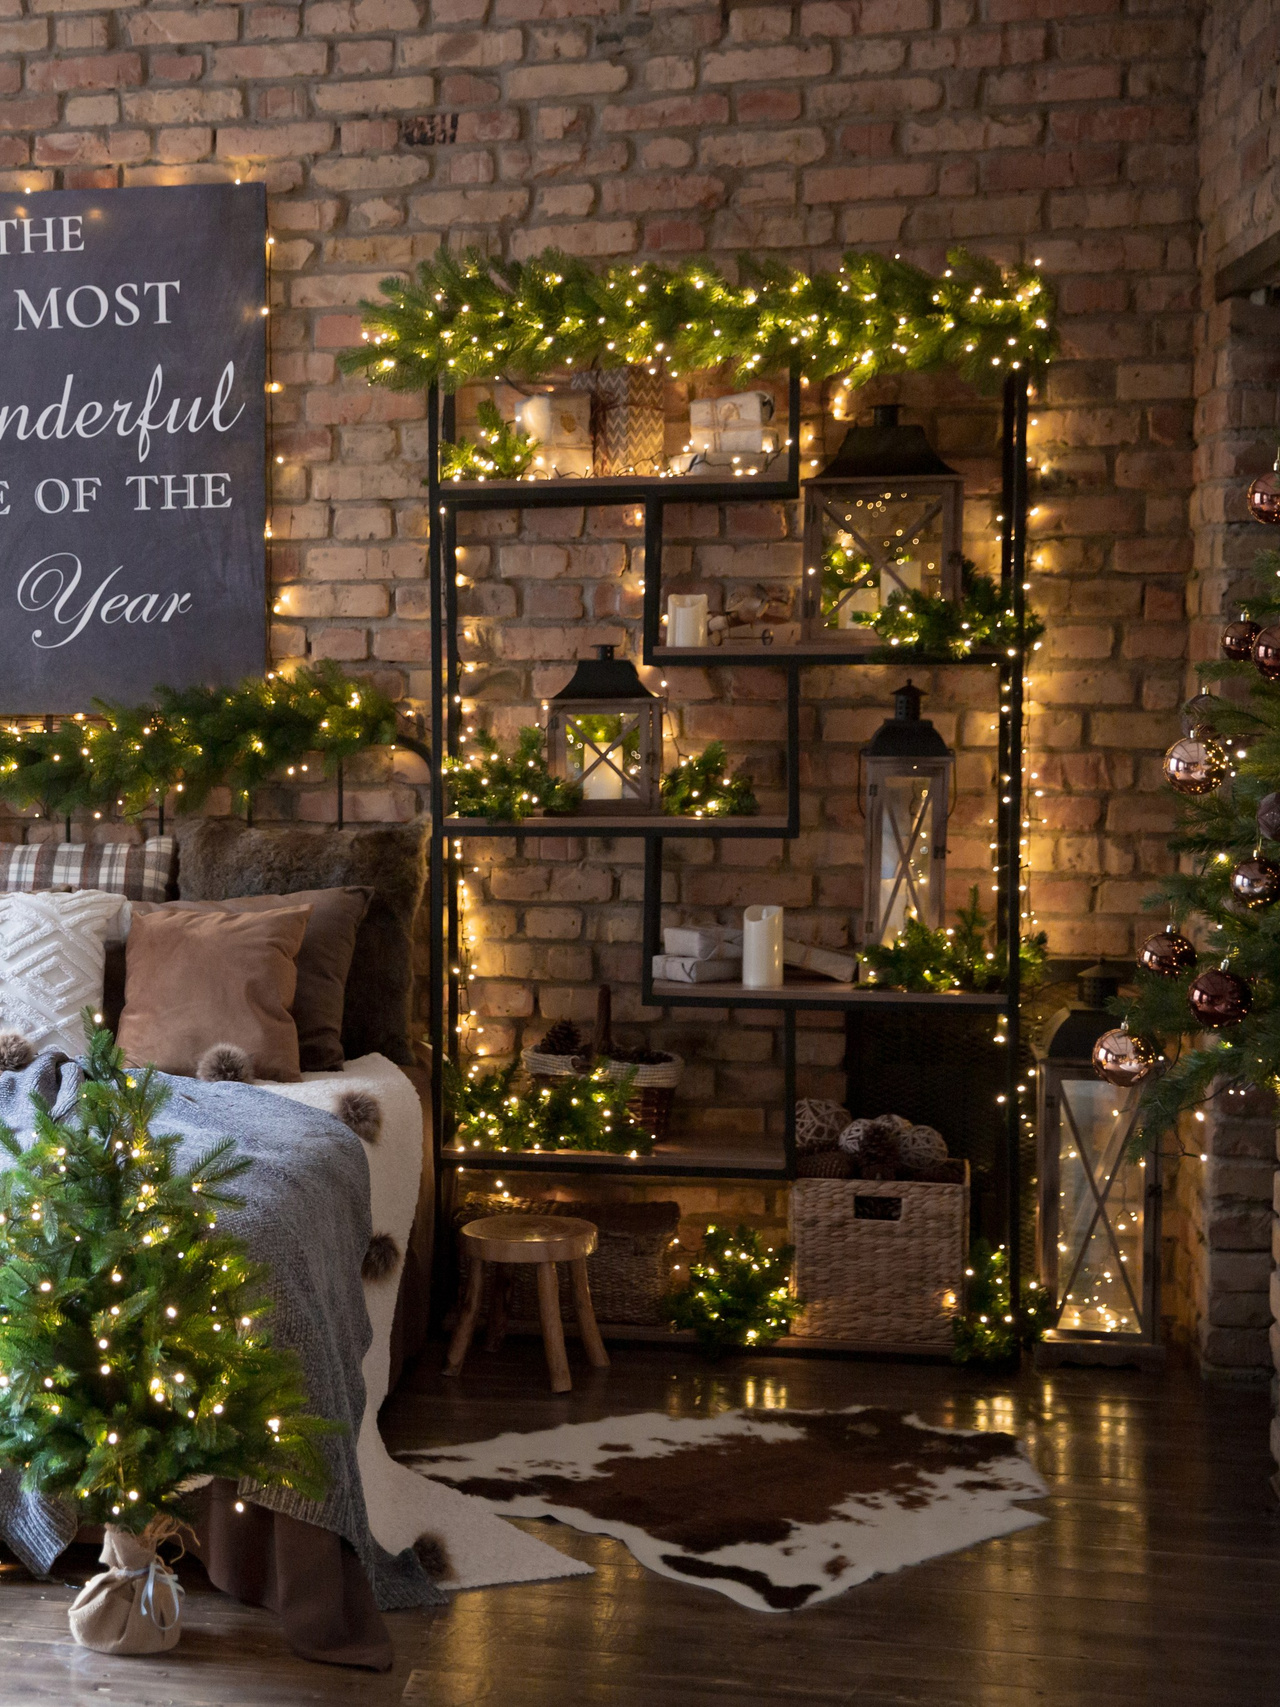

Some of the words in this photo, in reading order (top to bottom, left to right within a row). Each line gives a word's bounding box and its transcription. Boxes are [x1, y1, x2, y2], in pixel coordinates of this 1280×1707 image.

[13, 279, 181, 331] MOST
[34, 477, 102, 515] OF
[125, 472, 233, 511] THE
[17, 552, 192, 649] Year
